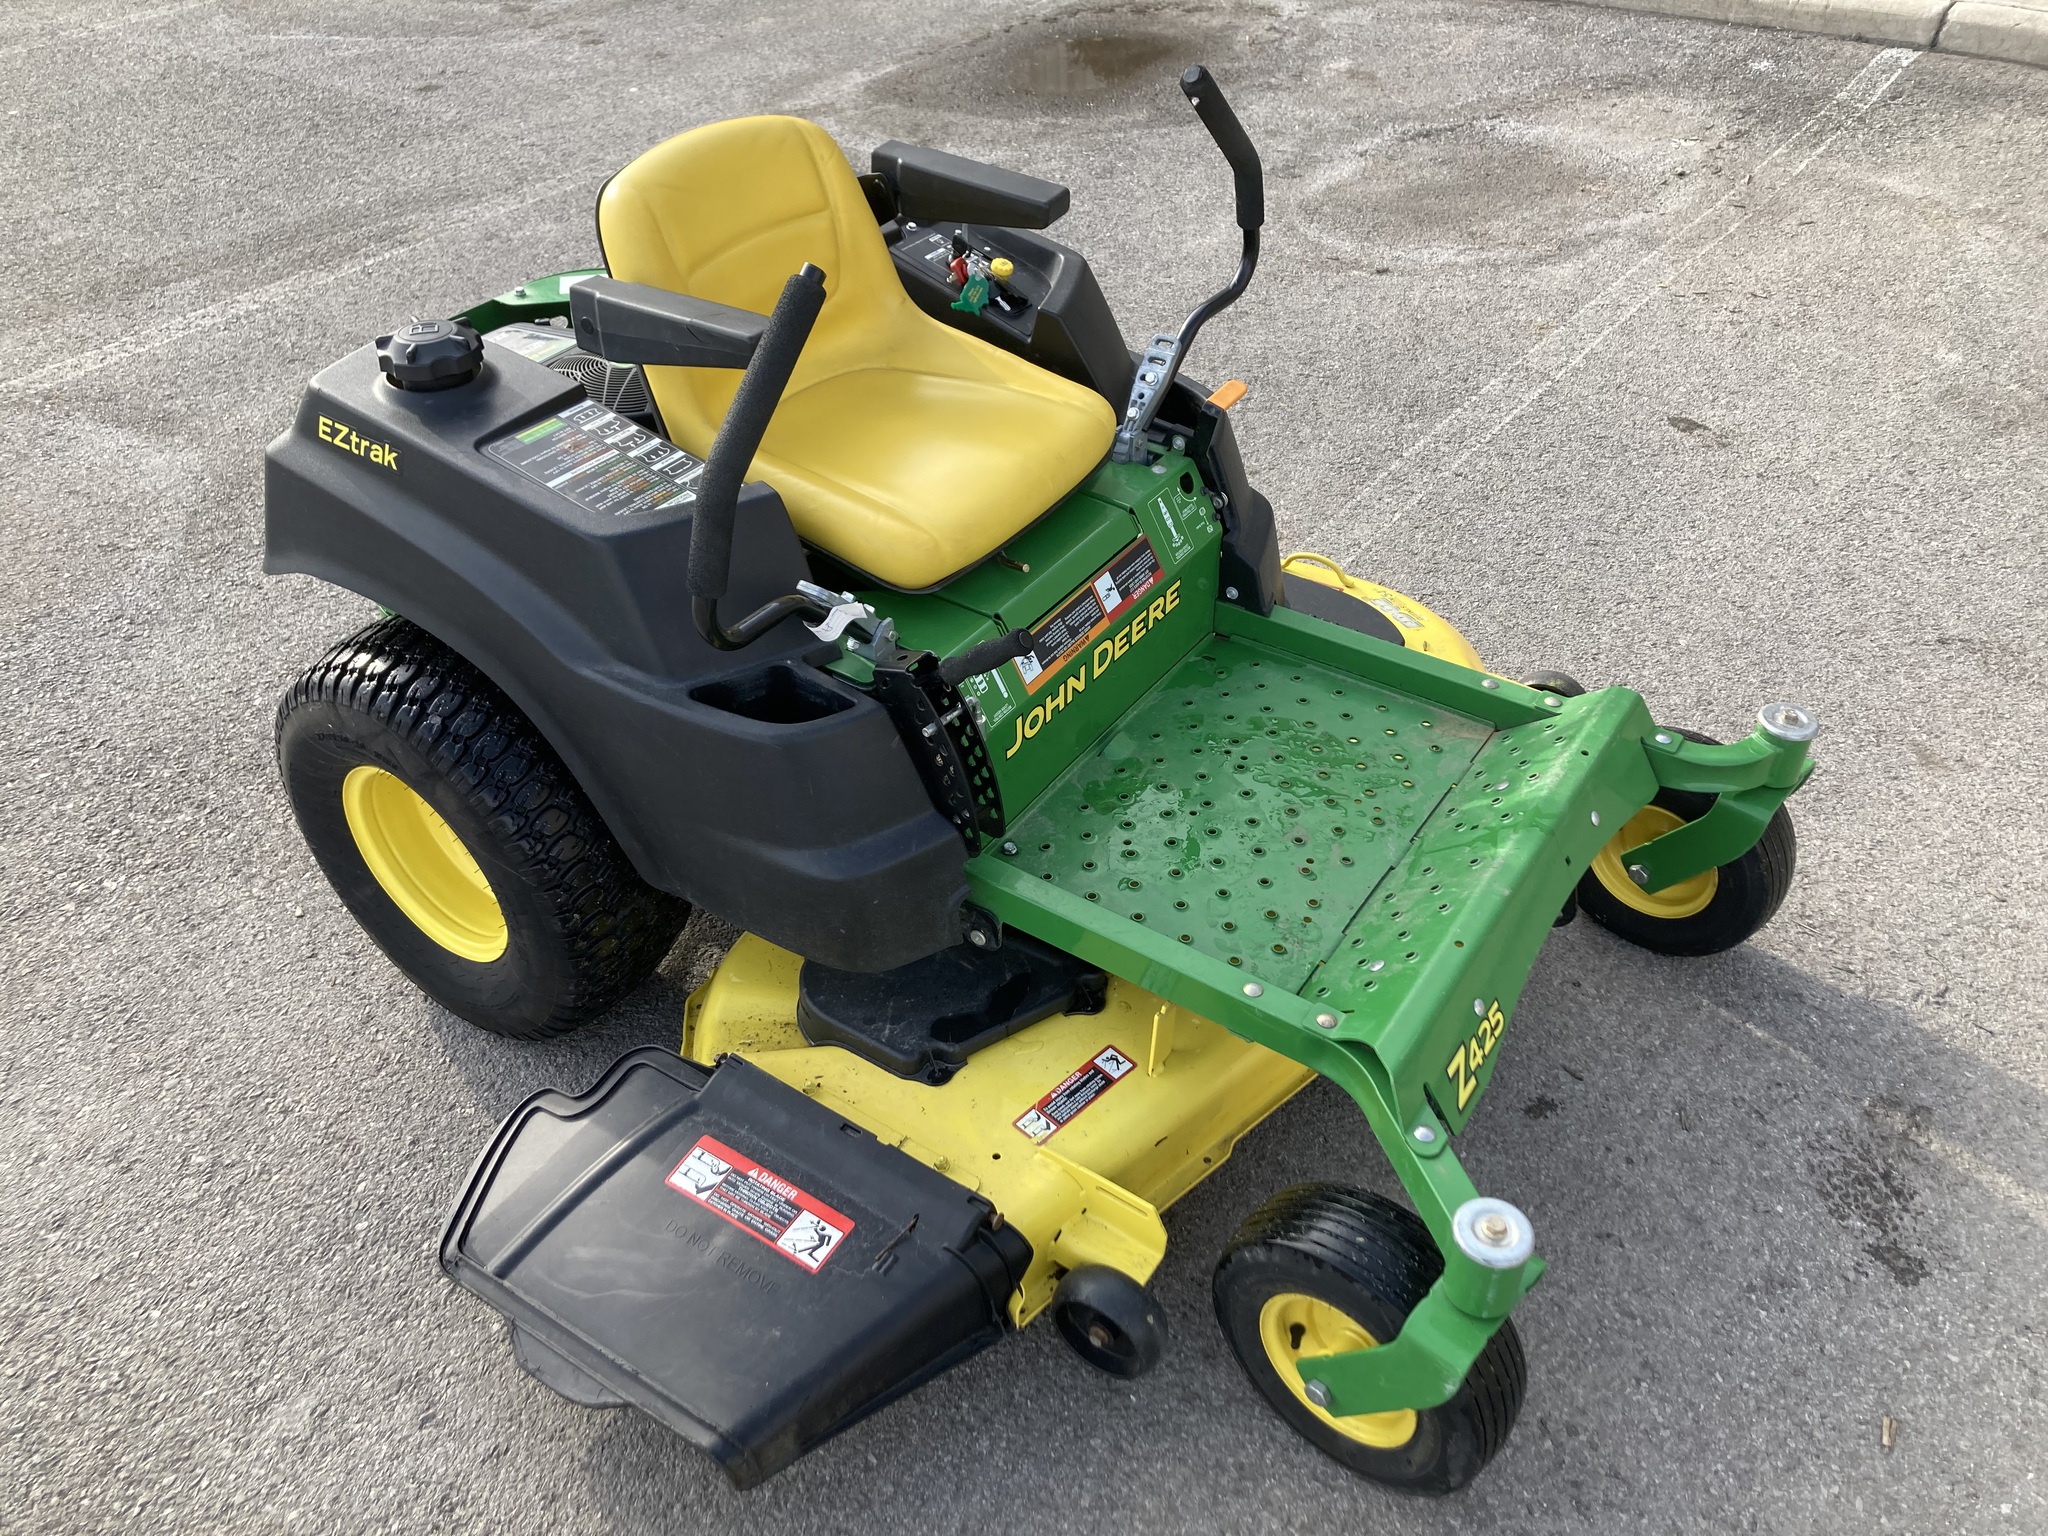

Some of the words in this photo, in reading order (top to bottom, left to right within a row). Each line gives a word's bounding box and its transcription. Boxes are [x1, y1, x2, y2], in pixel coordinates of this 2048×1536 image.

[318, 414, 399, 472] EZtrak
[1131, 580, 1150, 600] DANGER
[1006, 665, 1086, 760] JOHN
[1092, 578, 1181, 681] DEERE
[1062, 636, 1089, 662] WARNING
[1446, 997, 1505, 1115] Z425
[1054, 1071, 1082, 1094] DANGER
[757, 1172, 797, 1199] DANGER
[664, 1220, 685, 1239] DO
[716, 1251, 779, 1294] REMOVE
